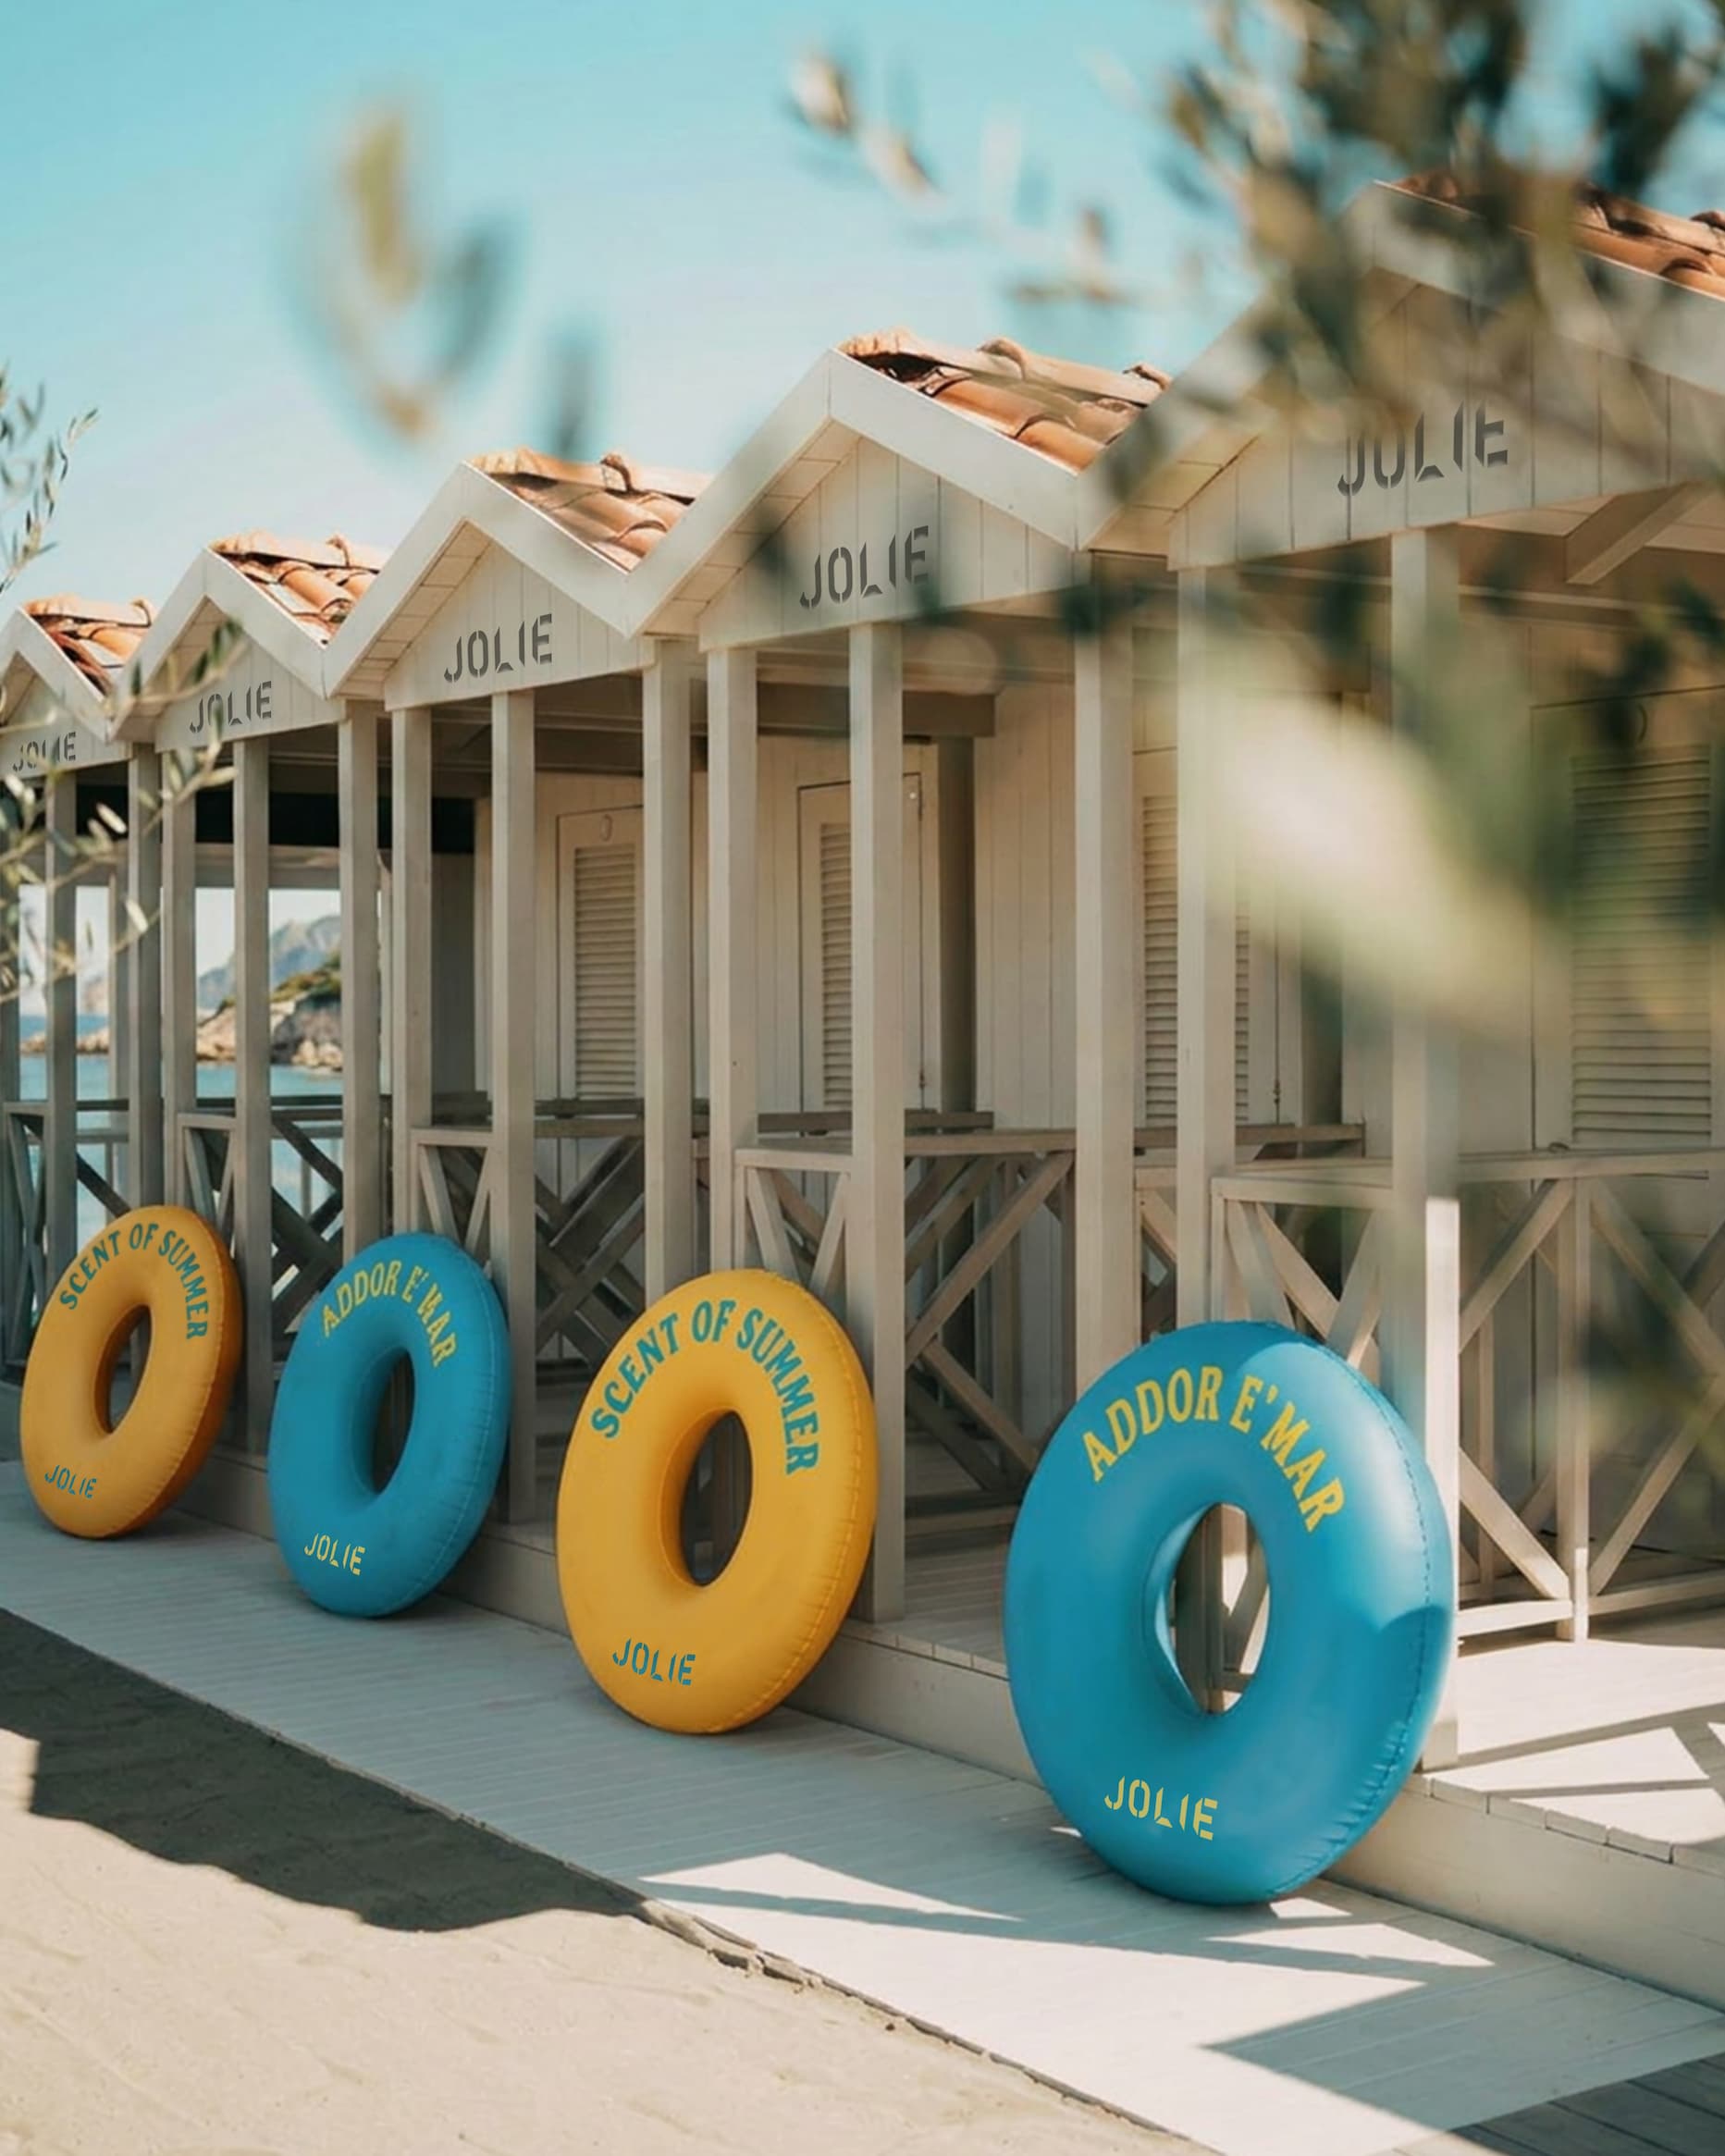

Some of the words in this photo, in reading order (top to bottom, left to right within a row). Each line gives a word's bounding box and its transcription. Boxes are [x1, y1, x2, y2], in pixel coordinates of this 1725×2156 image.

[799, 525, 930, 610] JOLIE
[443, 613, 553, 684] JOLIE
[58, 1230, 120, 1310] SCENT
[129, 1222, 159, 1250] OF
[157, 1230, 209, 1340] SUMMER
[321, 1259, 400, 1337] ADDOR
[591, 1312, 679, 1439] SCENT
[691, 1299, 737, 1343] OF
[736, 1308, 819, 1475] SUMMER
[43, 1465, 97, 1499] JOLIE
[1080, 1364, 1224, 1482] ADDOR
[1230, 1374, 1346, 1532] E'MAR
[303, 1533, 366, 1575] JOLIE
[612, 1638, 696, 1685] JOLIE
[1103, 1775, 1219, 1840] JOLIE
